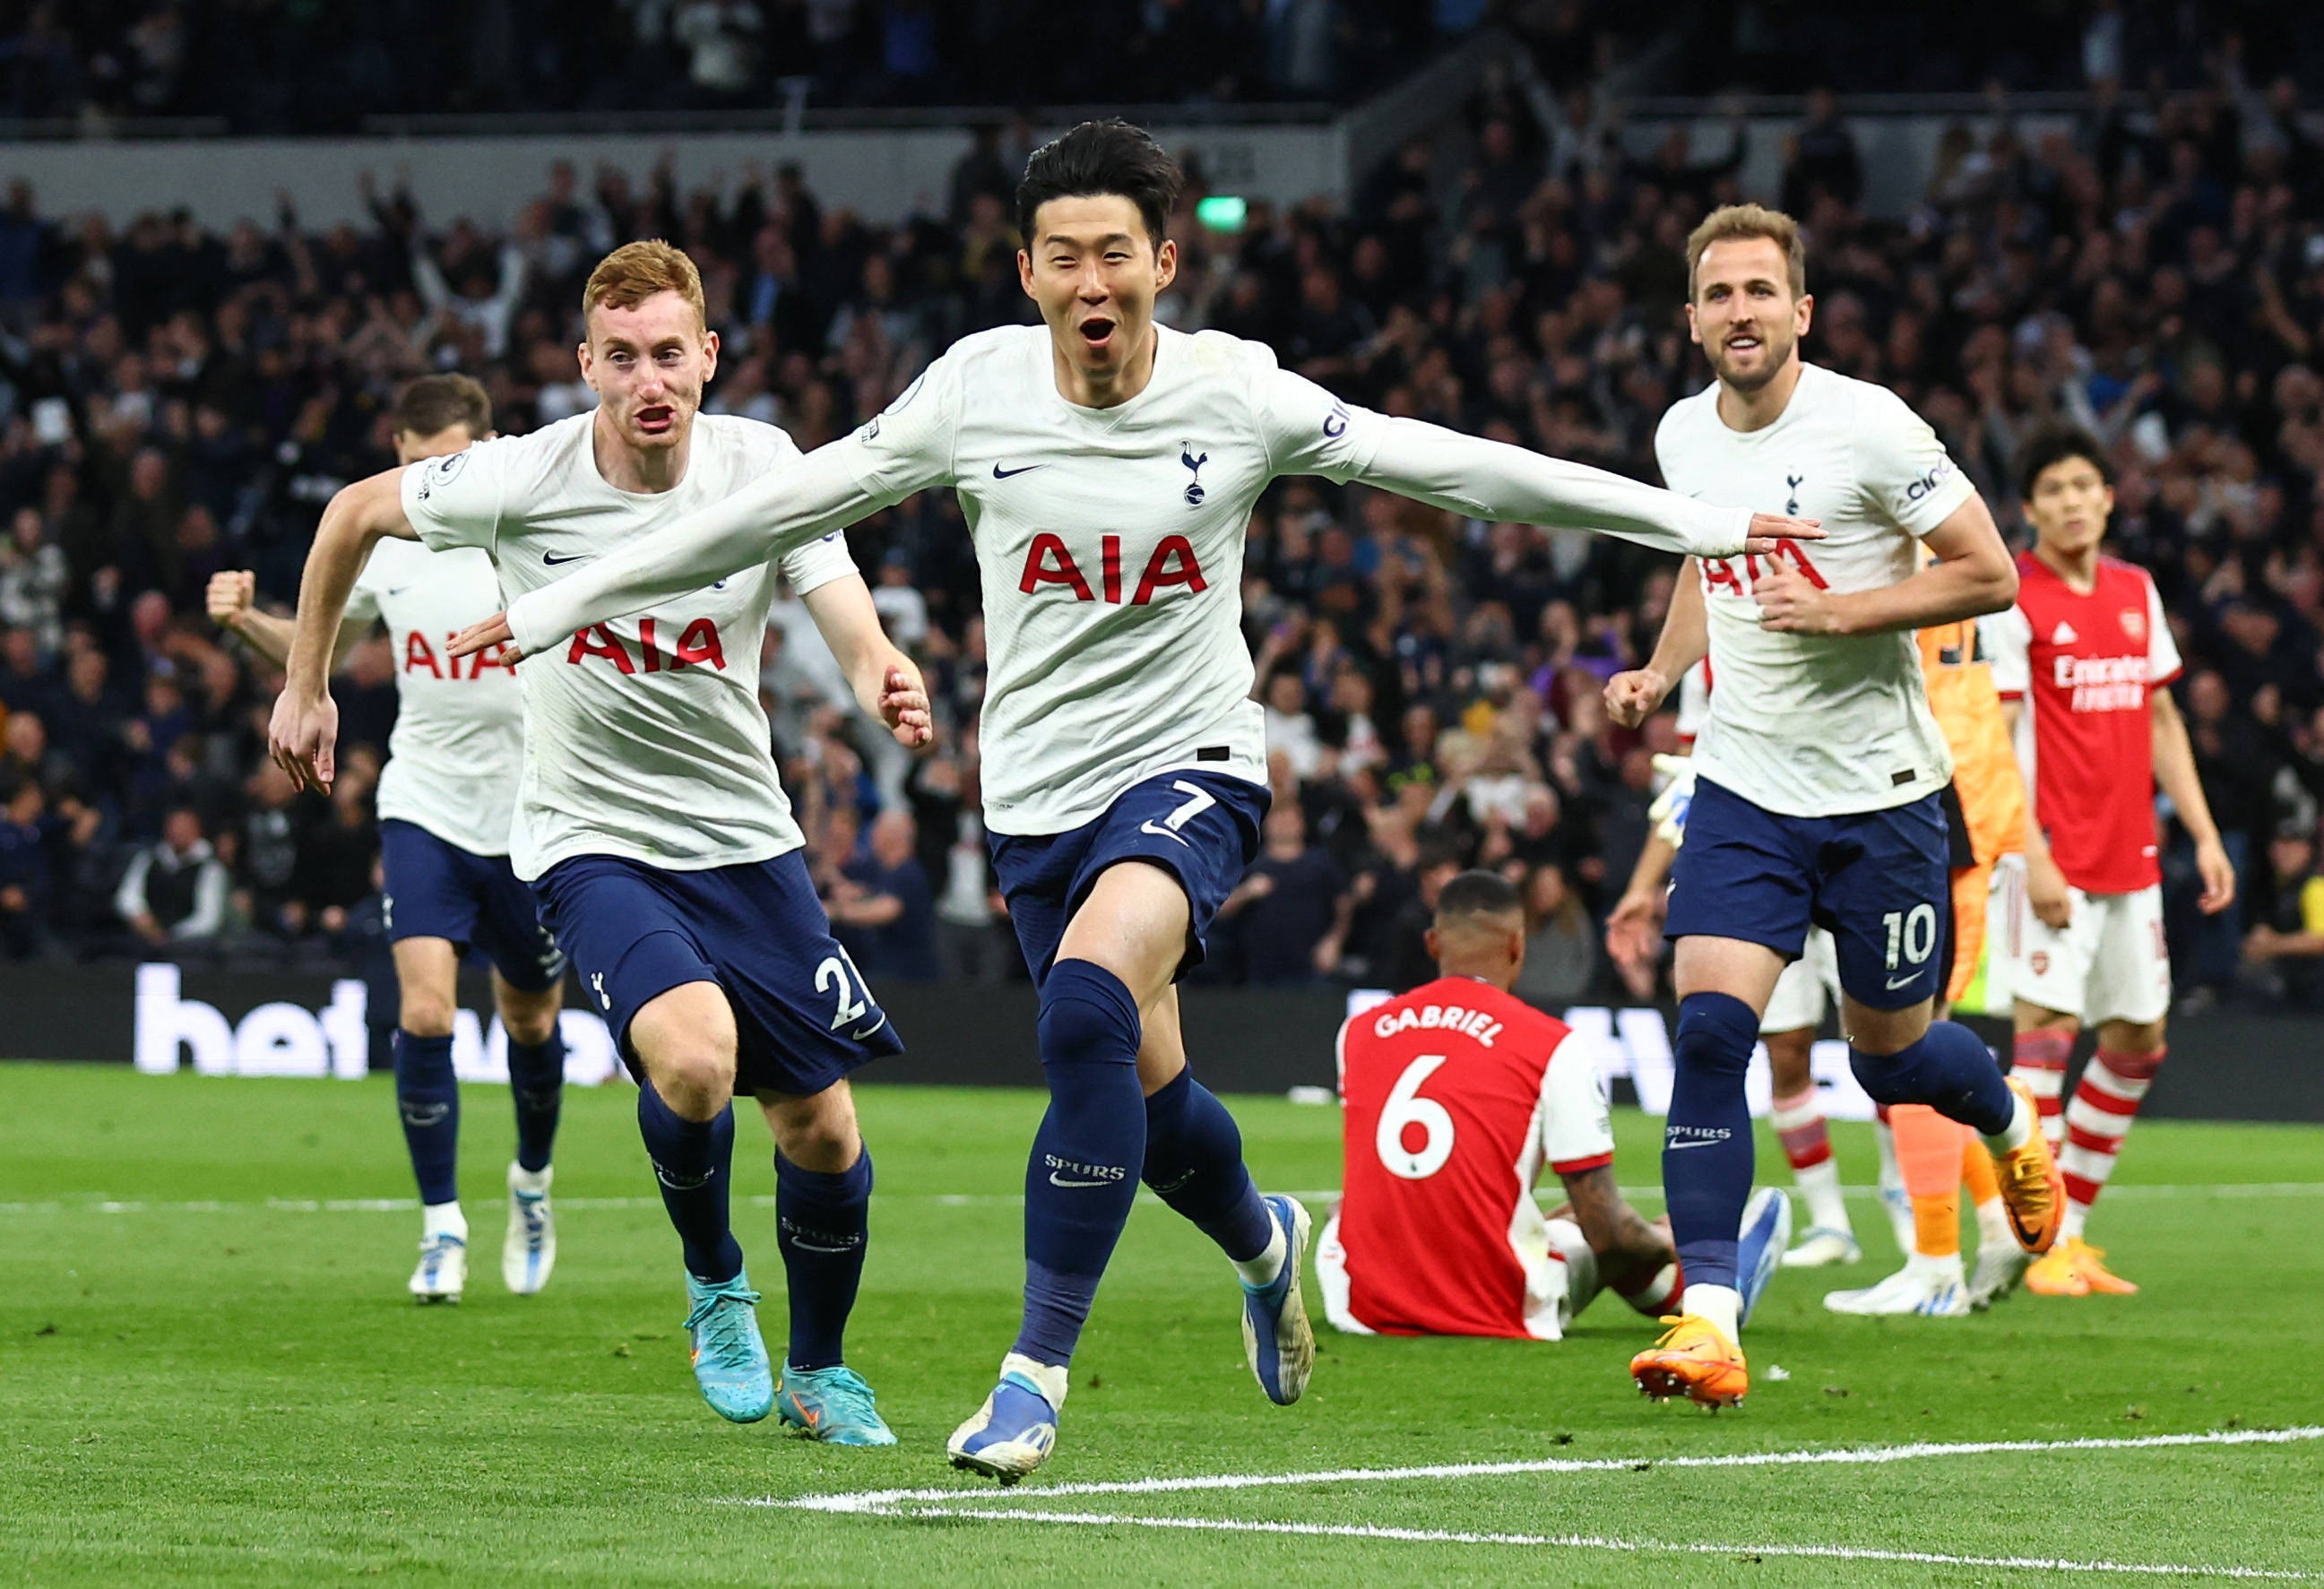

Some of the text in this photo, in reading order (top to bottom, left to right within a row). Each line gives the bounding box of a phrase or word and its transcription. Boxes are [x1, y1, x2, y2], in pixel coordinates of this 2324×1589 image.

[1018, 532, 1208, 605] AIA
[566, 617, 728, 674] AIA
[1163, 779, 1217, 832] 7
[1882, 902, 1936, 971] 10
[1374, 1005, 1504, 1048] GABRIEL
[1375, 1054, 1456, 1179] 6
[1666, 1125, 1732, 1139] SPURS
[1045, 1153, 1126, 1180] SPURS
